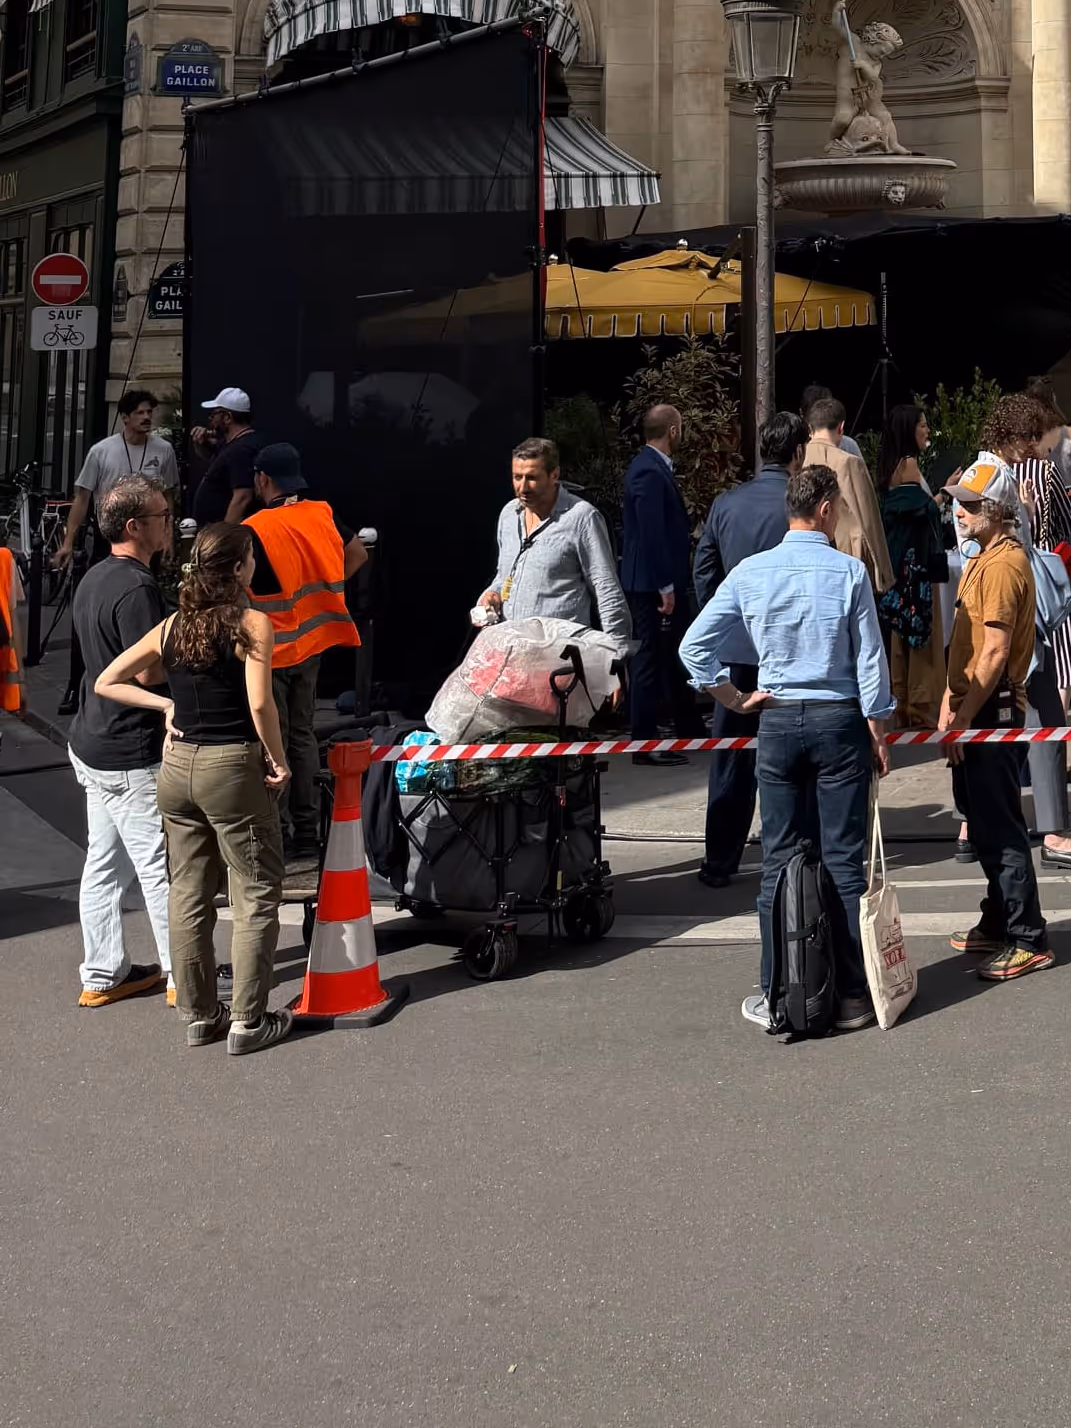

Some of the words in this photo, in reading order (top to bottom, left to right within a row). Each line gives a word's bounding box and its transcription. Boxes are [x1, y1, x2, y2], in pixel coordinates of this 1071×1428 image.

[174, 65, 210, 75] PLACE
[166, 76, 216, 87] GAILLON
[161, 286, 184, 296] PLA
[155, 300, 183, 310] GAIL
[48, 309, 83, 320] SAUF
